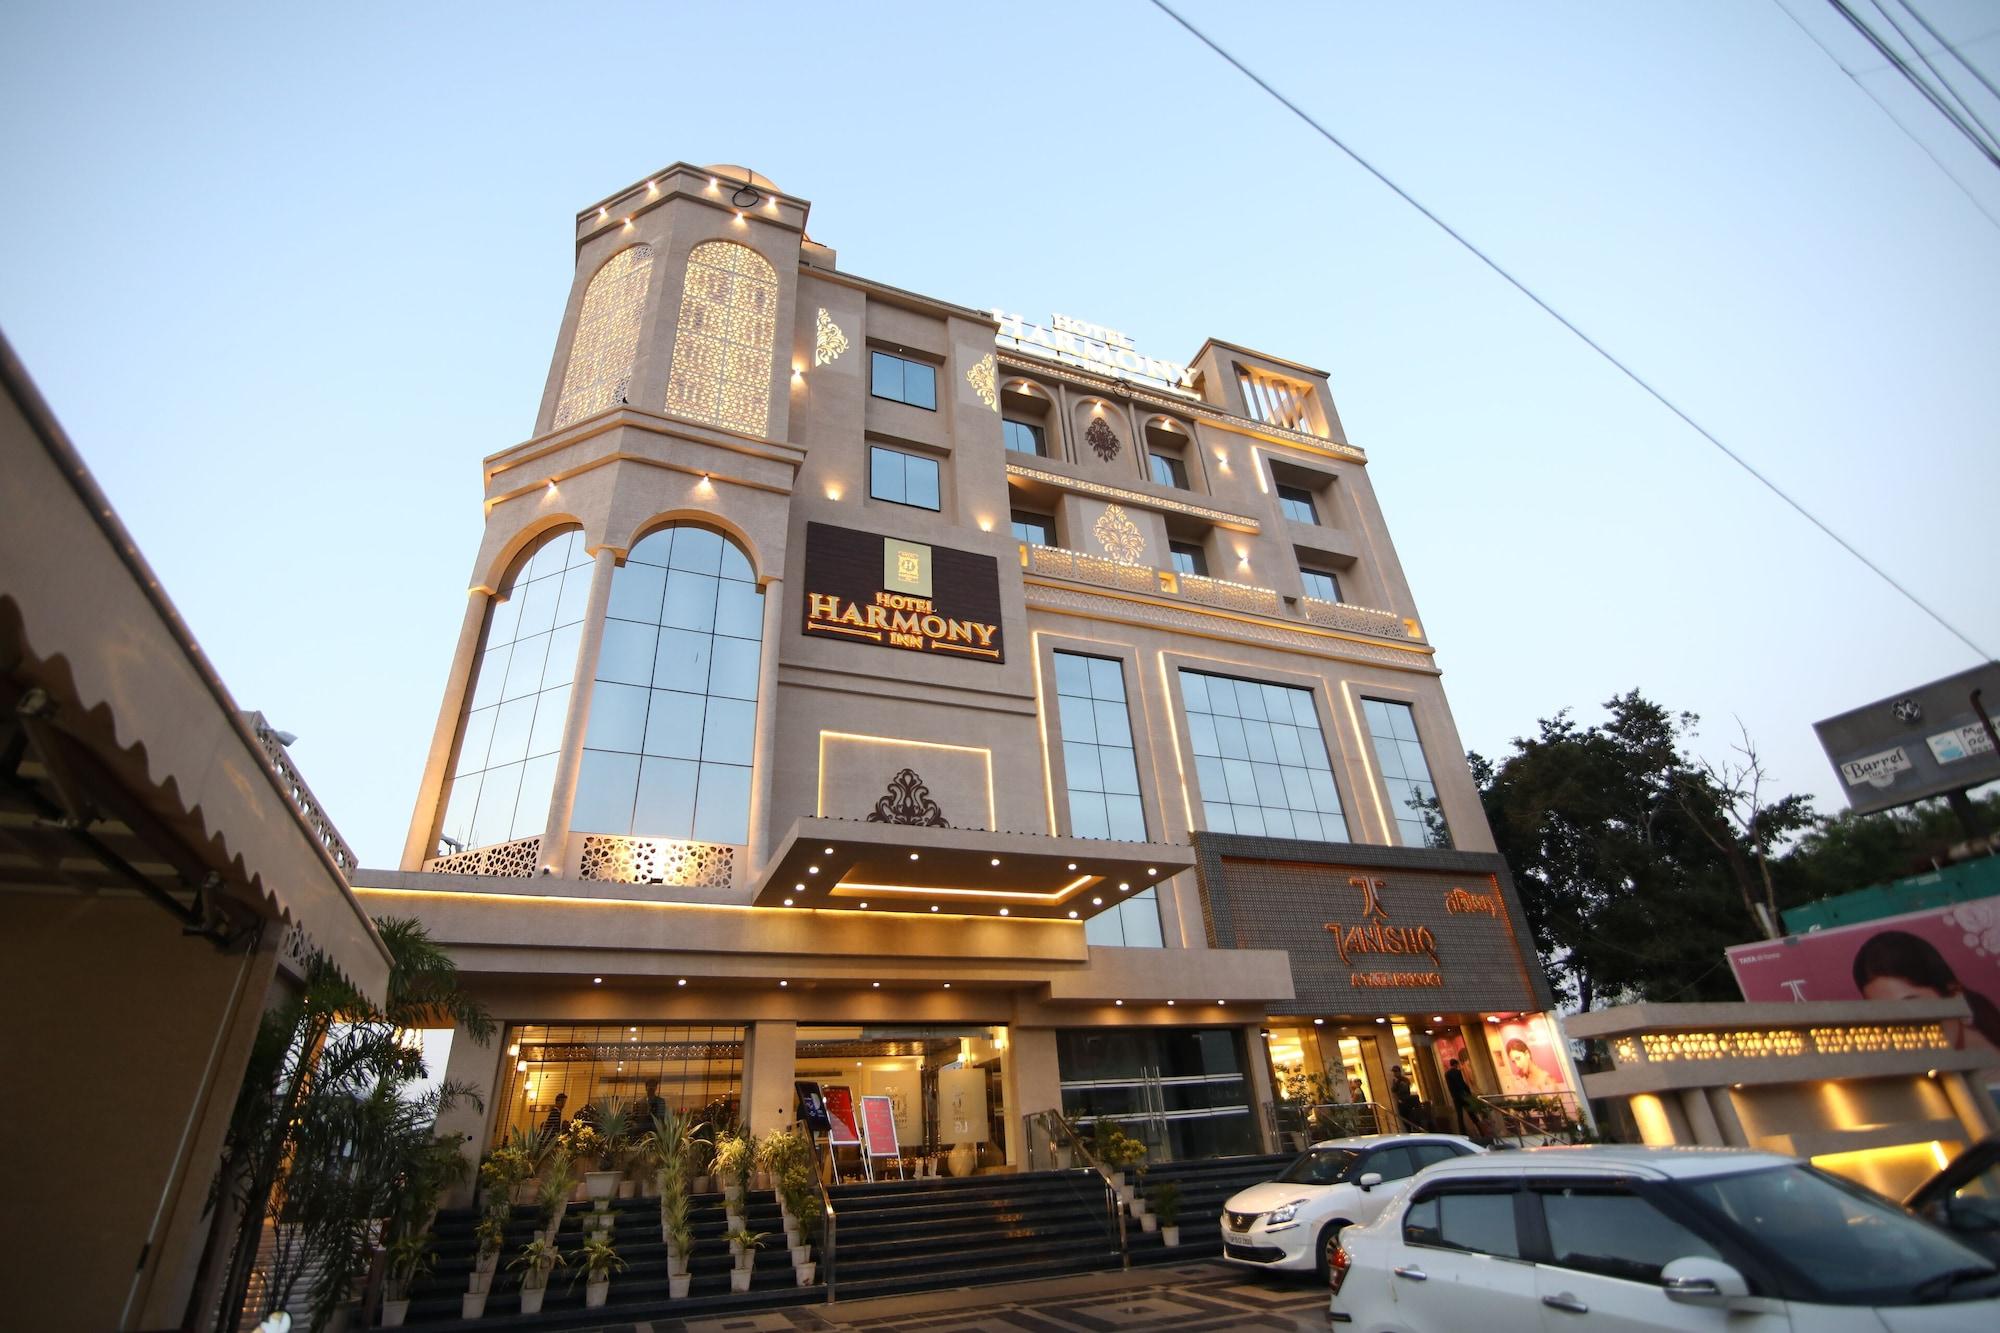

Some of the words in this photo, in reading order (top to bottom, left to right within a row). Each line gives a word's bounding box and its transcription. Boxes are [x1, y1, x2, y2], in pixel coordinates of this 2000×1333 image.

[991, 308, 1197, 388] HARMONY
[876, 592, 937, 614] HOTEL
[808, 592, 997, 646] HARMONY
[889, 632, 923, 649] INN
[1844, 748, 1904, 779] Barrel
